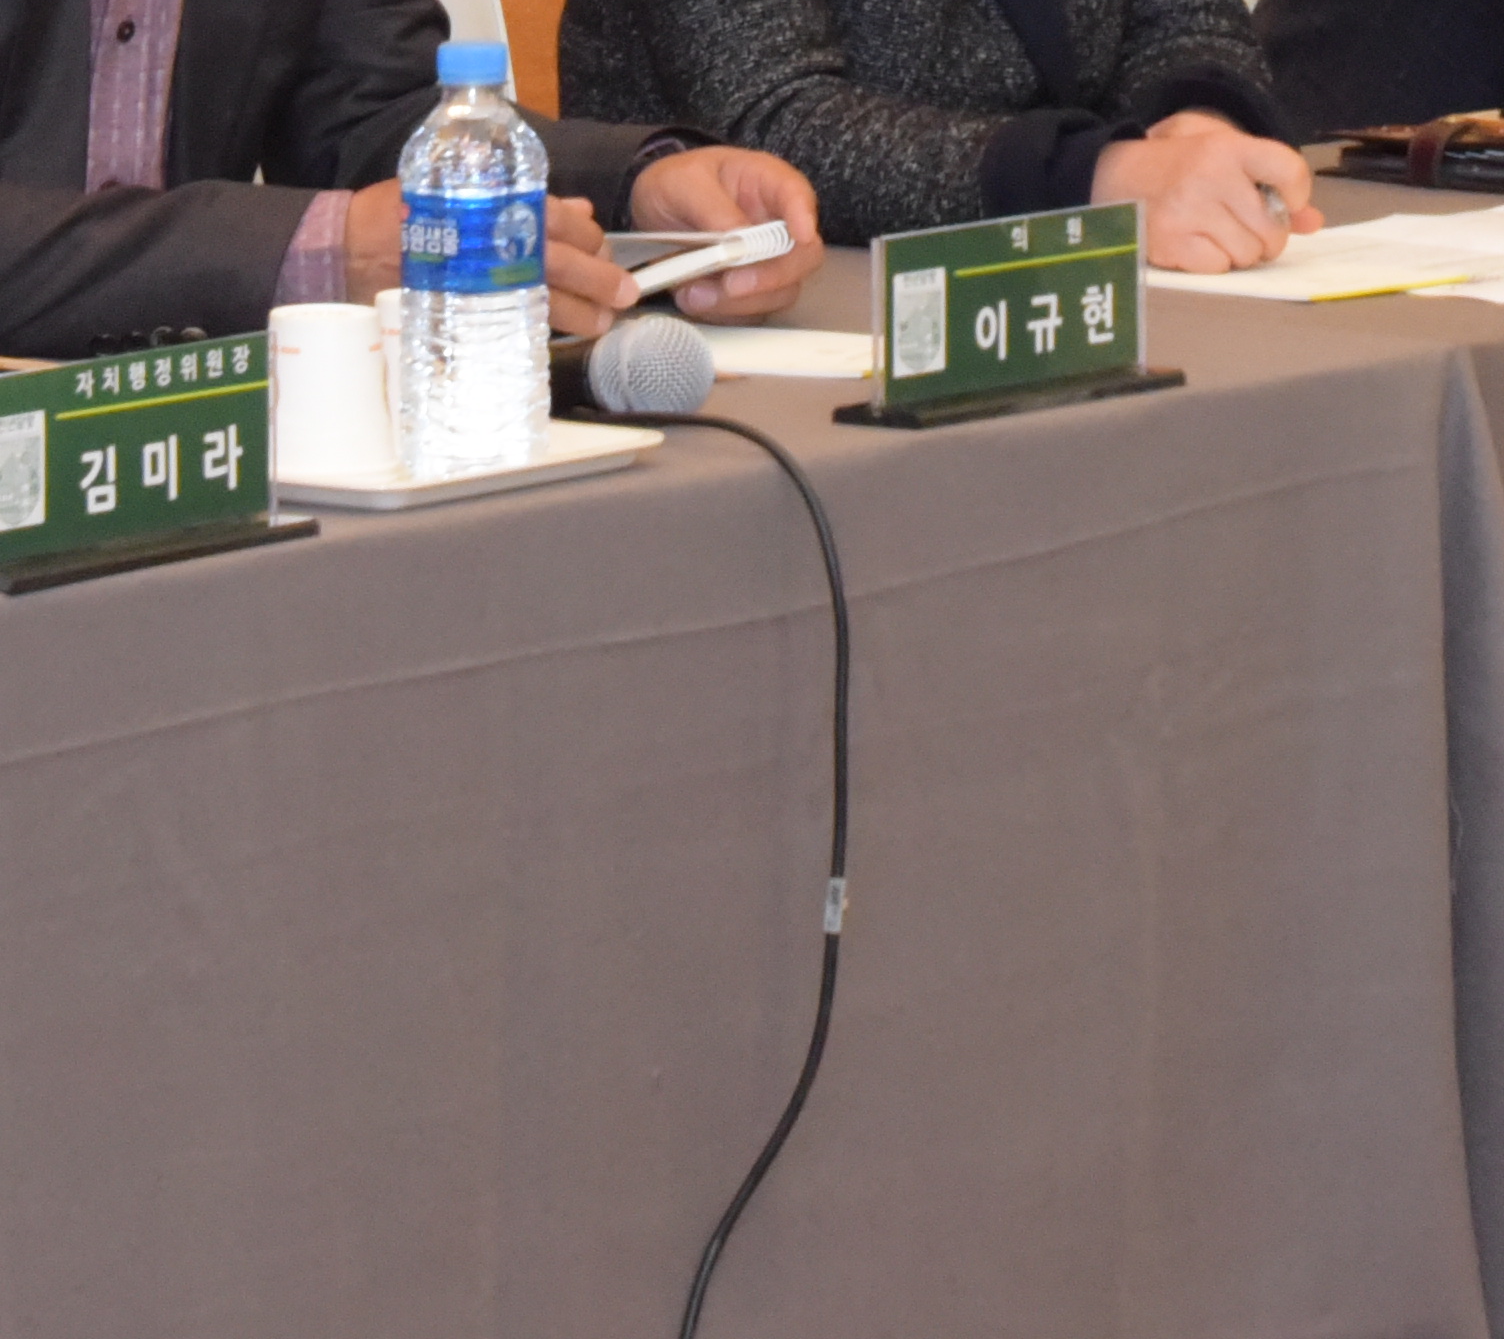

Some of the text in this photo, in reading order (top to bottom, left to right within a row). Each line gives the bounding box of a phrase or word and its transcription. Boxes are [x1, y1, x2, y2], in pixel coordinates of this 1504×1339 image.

[974, 282, 1116, 361] 이규현
[74, 343, 251, 399] 자치행정위원장
[80, 423, 244, 515] 김미라
